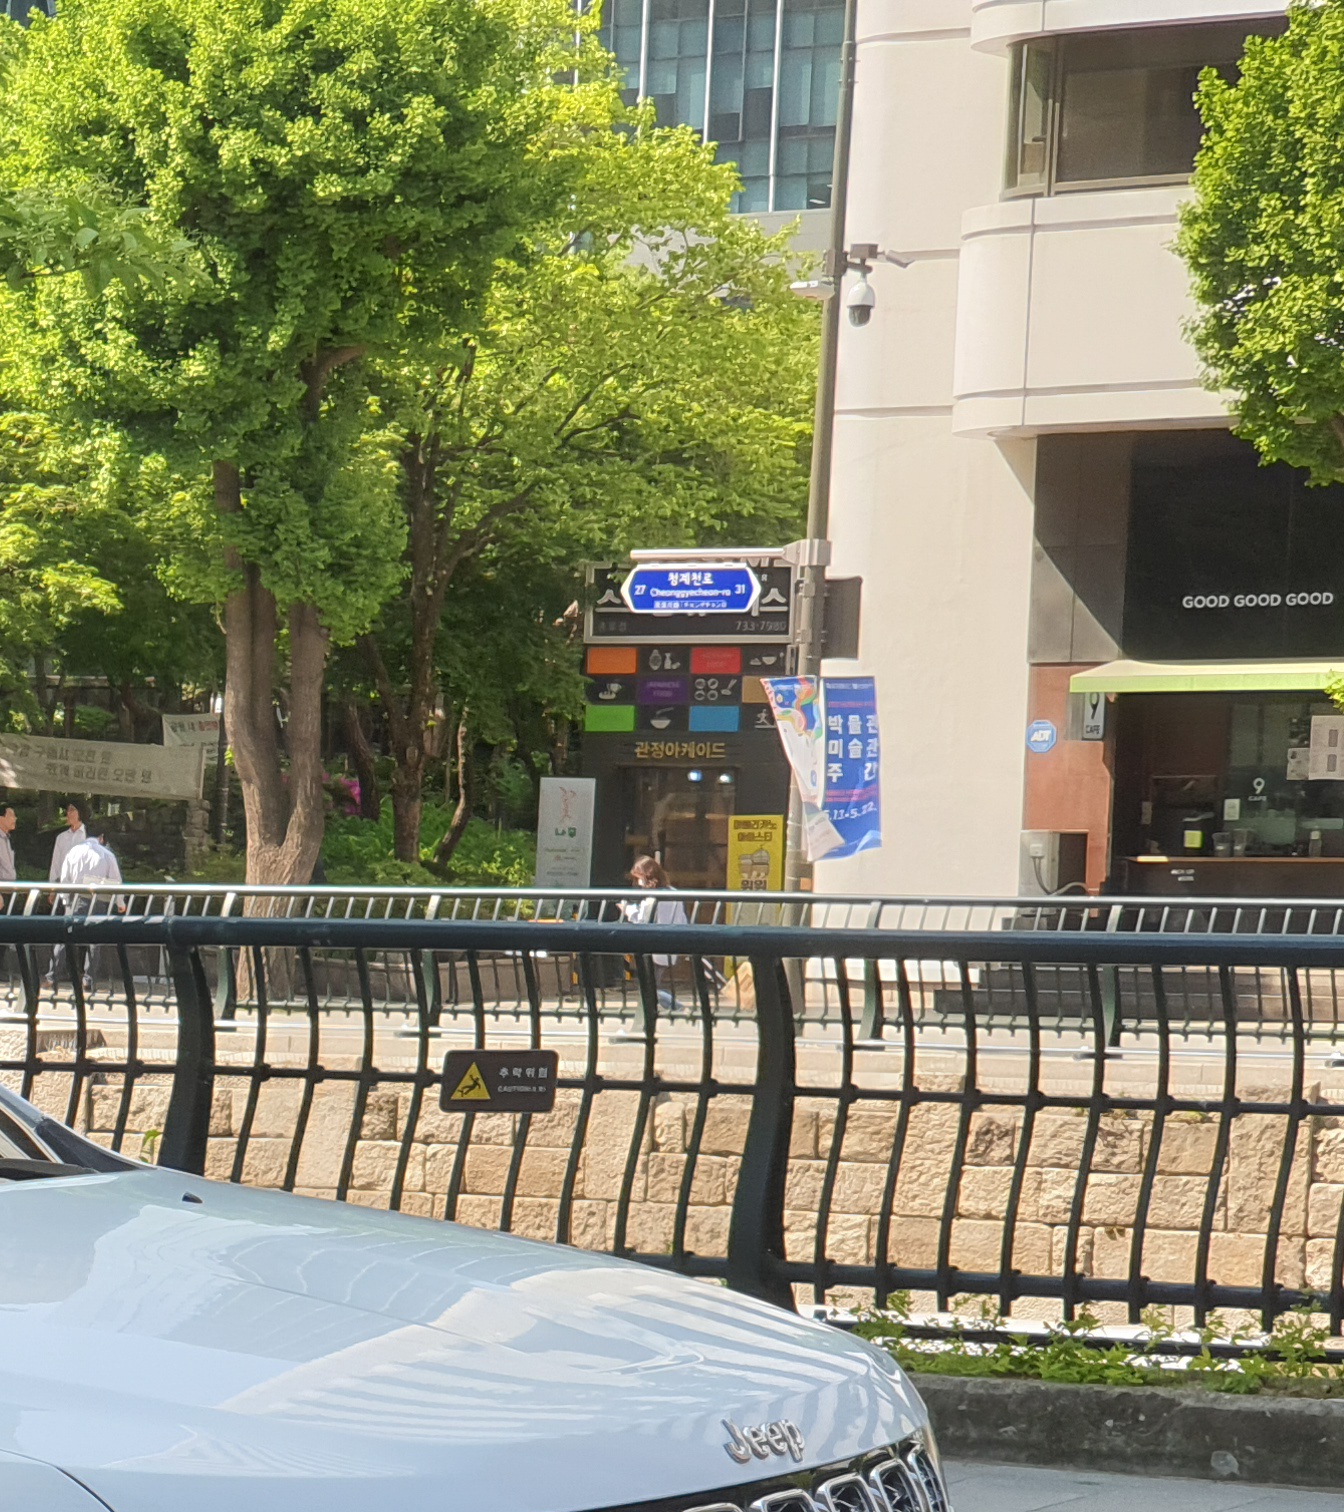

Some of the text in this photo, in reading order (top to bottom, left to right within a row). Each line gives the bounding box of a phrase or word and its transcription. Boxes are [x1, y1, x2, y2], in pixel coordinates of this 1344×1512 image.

[667, 572, 714, 586] 청계천로
[634, 585, 647, 595] 27
[734, 584, 746, 595] 31
[1182, 592, 1334, 609] GOOD GOOD GOOD
[1030, 729, 1052, 742] ADT
[634, 741, 726, 759] 관정아케이드
[721, 1418, 805, 1465] Jeep
